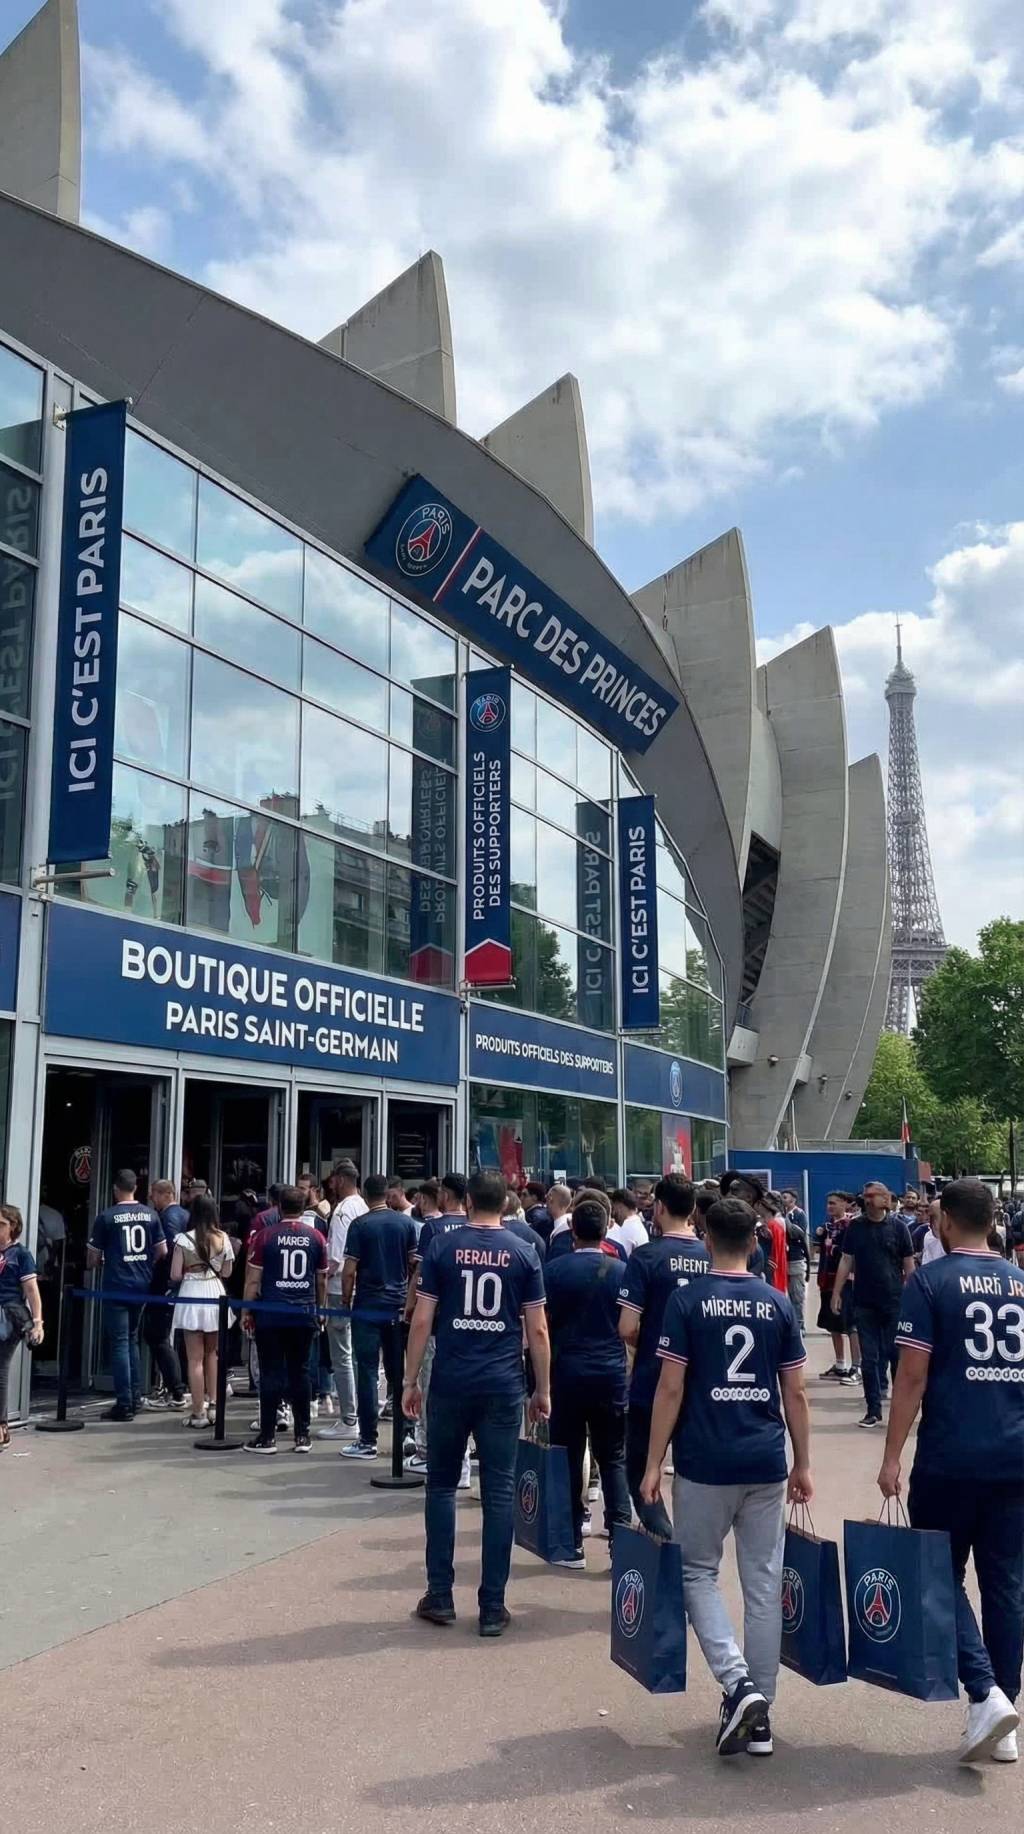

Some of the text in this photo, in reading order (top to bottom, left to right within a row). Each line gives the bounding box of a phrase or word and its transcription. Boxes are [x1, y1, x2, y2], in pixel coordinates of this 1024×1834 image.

[422, 507, 450, 535] PARIS
[68, 467, 108, 793] ICI C'EST PARIS
[461, 556, 667, 736] PARC DES PRINCES
[473, 751, 485, 920] PRODUITS OFFICIELS
[490, 759, 501, 906] DES SUPPORTERS
[628, 826, 649, 993] ICI C'EST PARIS
[121, 938, 424, 1032] BOUTIQUE OFFICIELLE
[166, 1001, 399, 1063] PARIS SAINT-GERMAIN
[476, 1033, 520, 1057] PRODUITS
[522, 1043, 559, 1065] OFFICIELS
[560, 1050, 574, 1067] DES
[122, 1225, 146, 1253] 10
[280, 1249, 308, 1280] 10
[461, 1269, 503, 1317] 10
[725, 1324, 756, 1382] 2
[964, 1301, 1024, 1362] 33
[783, 1571, 801, 1591] ARIS
[863, 1572, 895, 1591] PARIS
